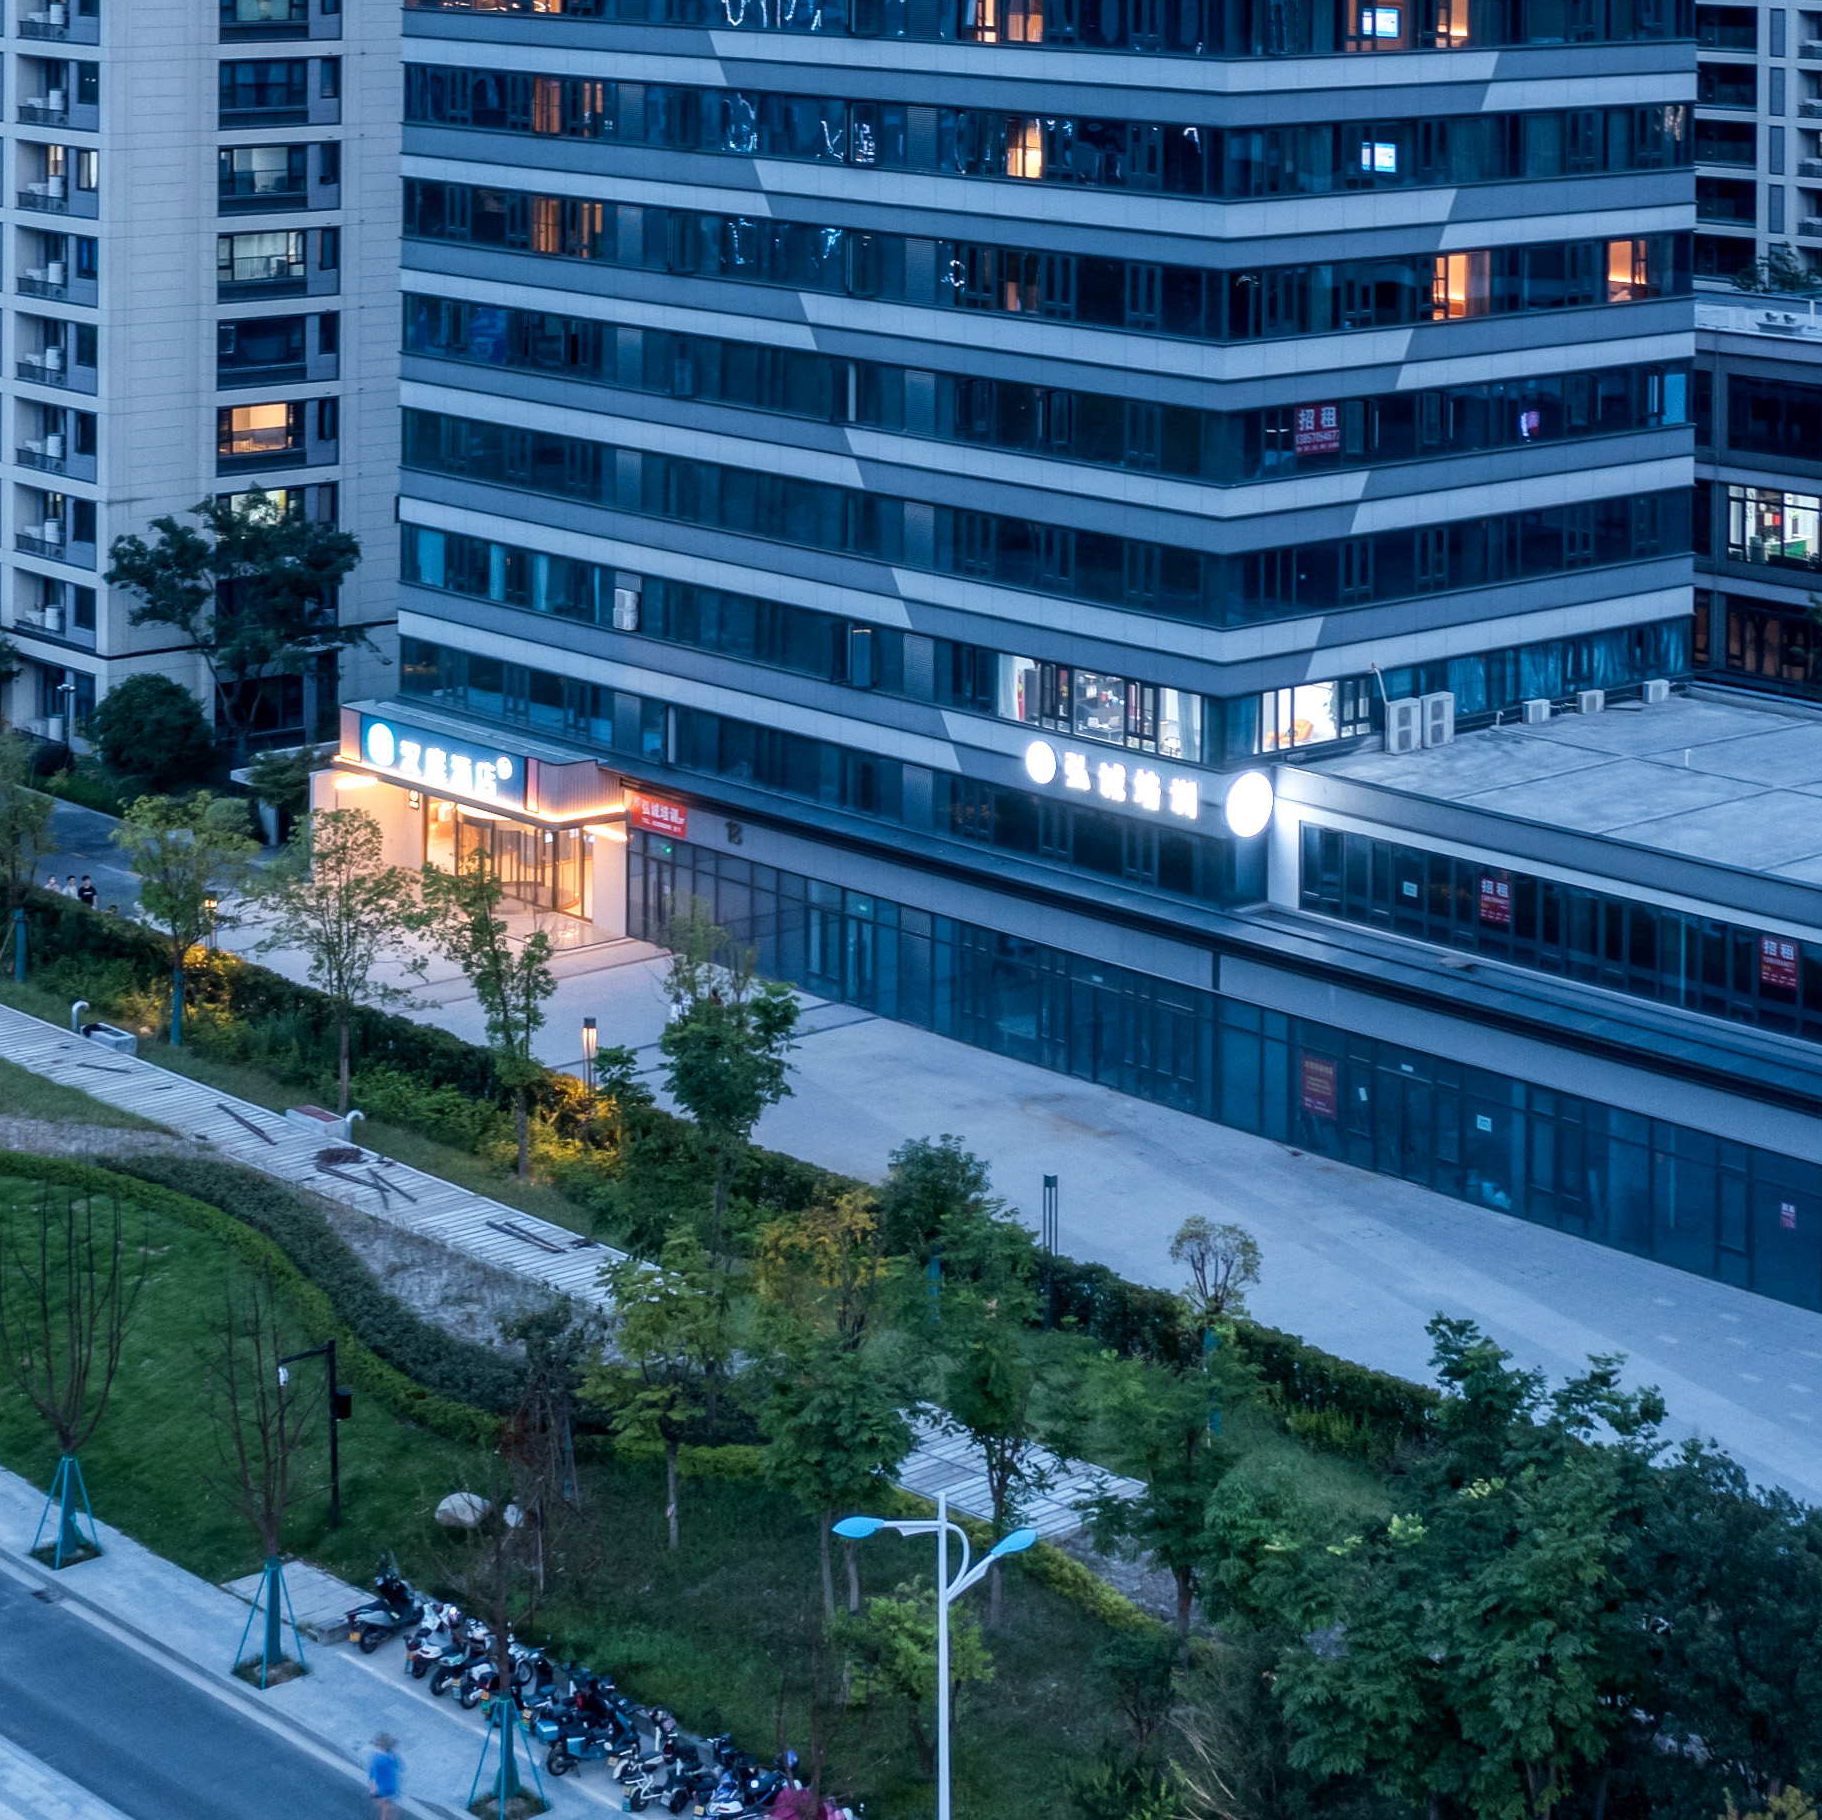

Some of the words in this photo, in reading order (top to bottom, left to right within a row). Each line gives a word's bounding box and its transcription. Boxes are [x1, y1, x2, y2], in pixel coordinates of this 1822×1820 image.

[1299, 406, 1337, 431] 招租
[1481, 879, 1509, 898] 招租
[1763, 940, 1794, 960] 招租
